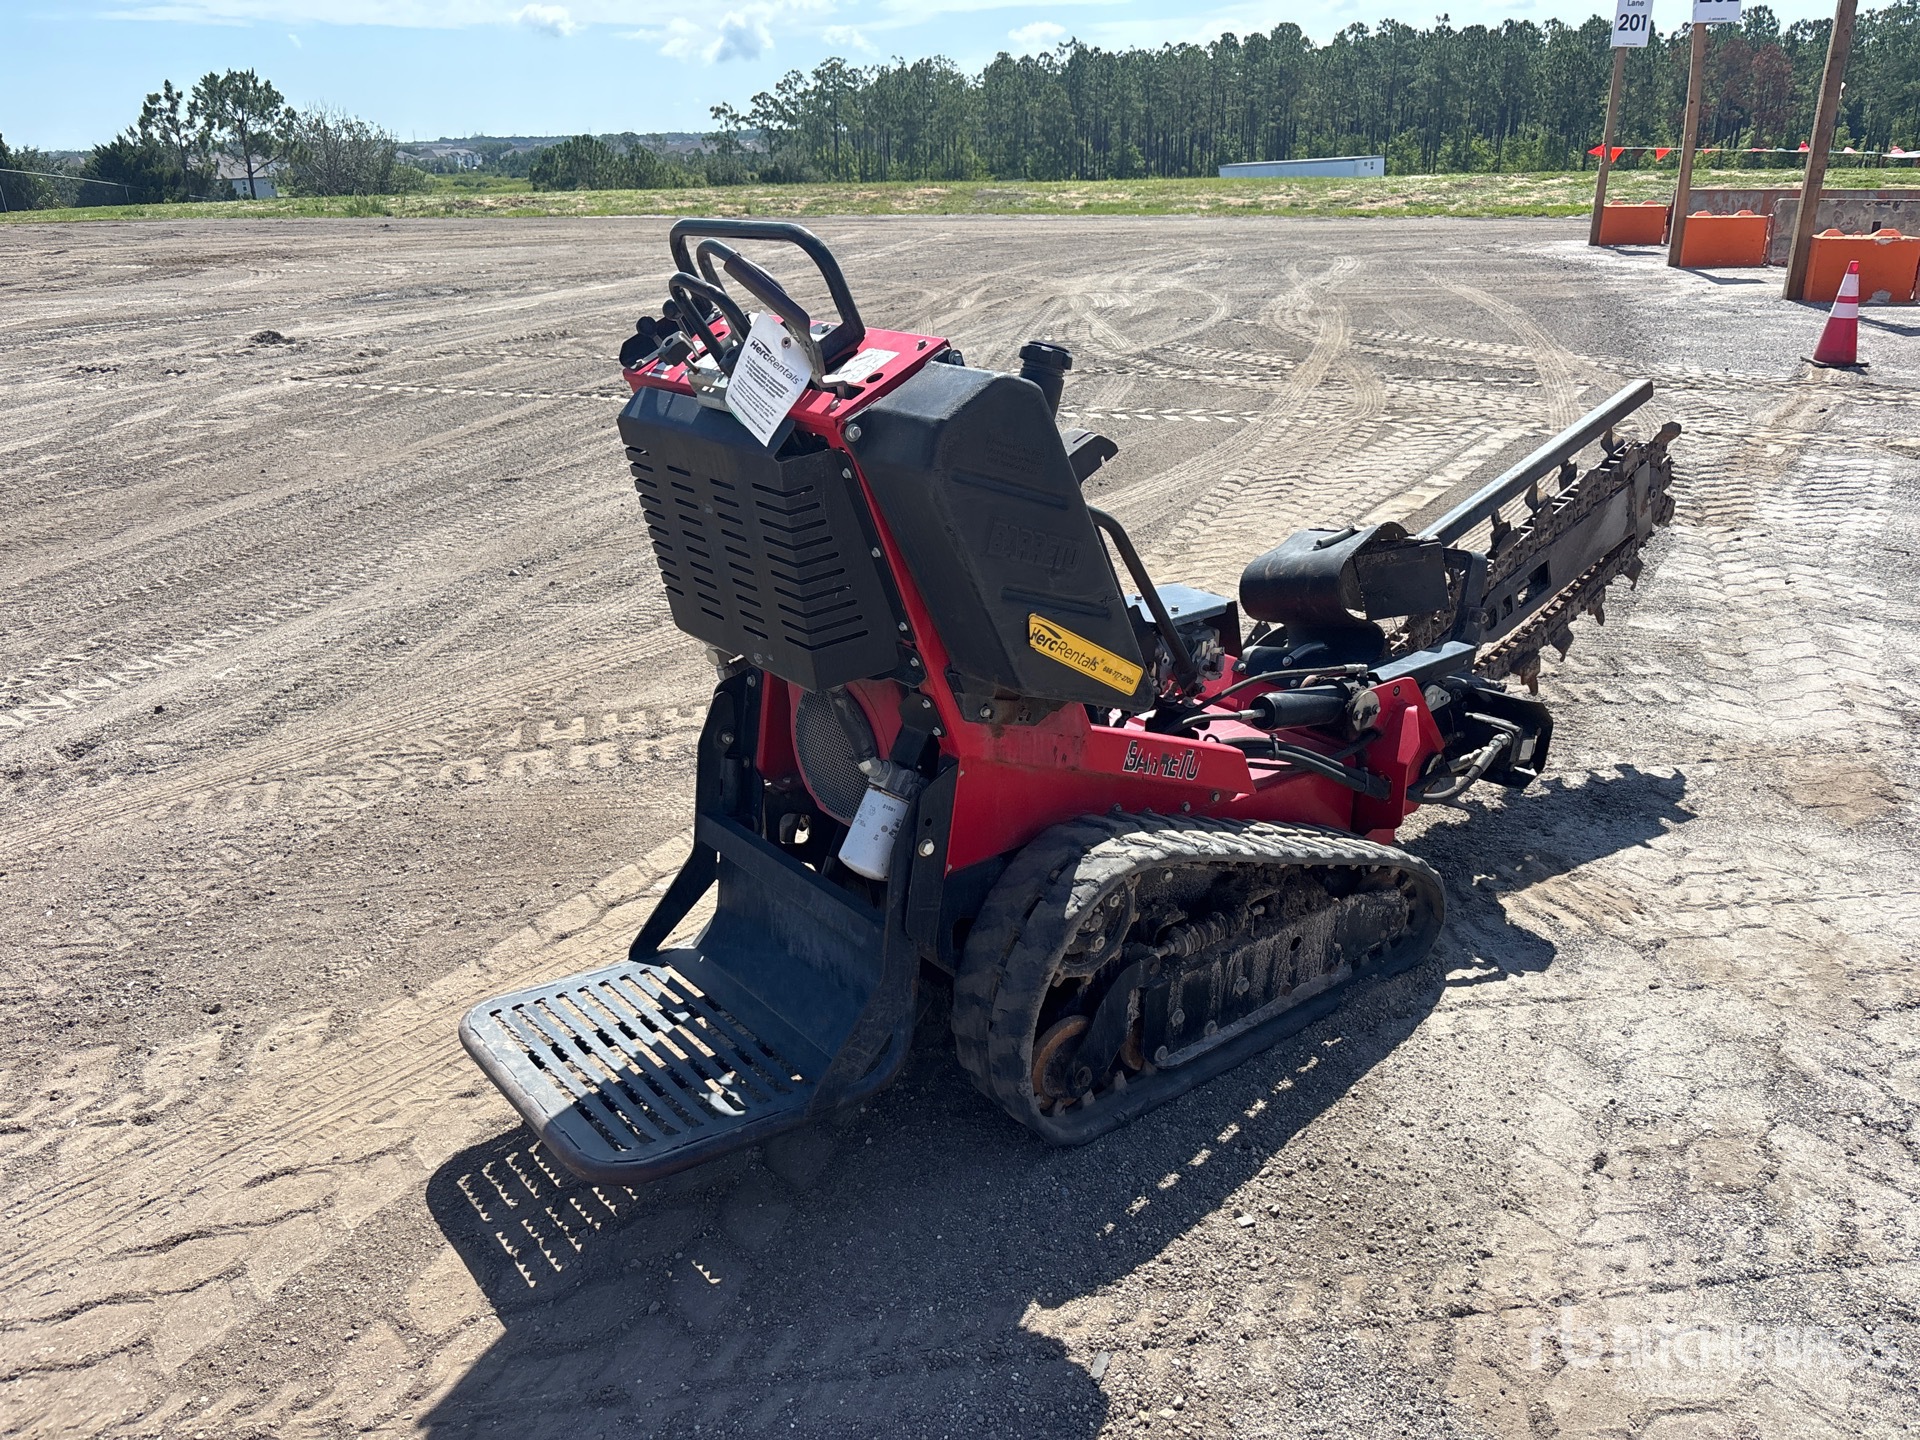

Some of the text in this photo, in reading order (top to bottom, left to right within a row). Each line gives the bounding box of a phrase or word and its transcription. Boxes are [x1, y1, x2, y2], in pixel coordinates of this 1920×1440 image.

[1617, 13, 1647, 31] 201
[749, 340, 801, 385] HercRentals
[1030, 627, 1100, 672] HercRentals
